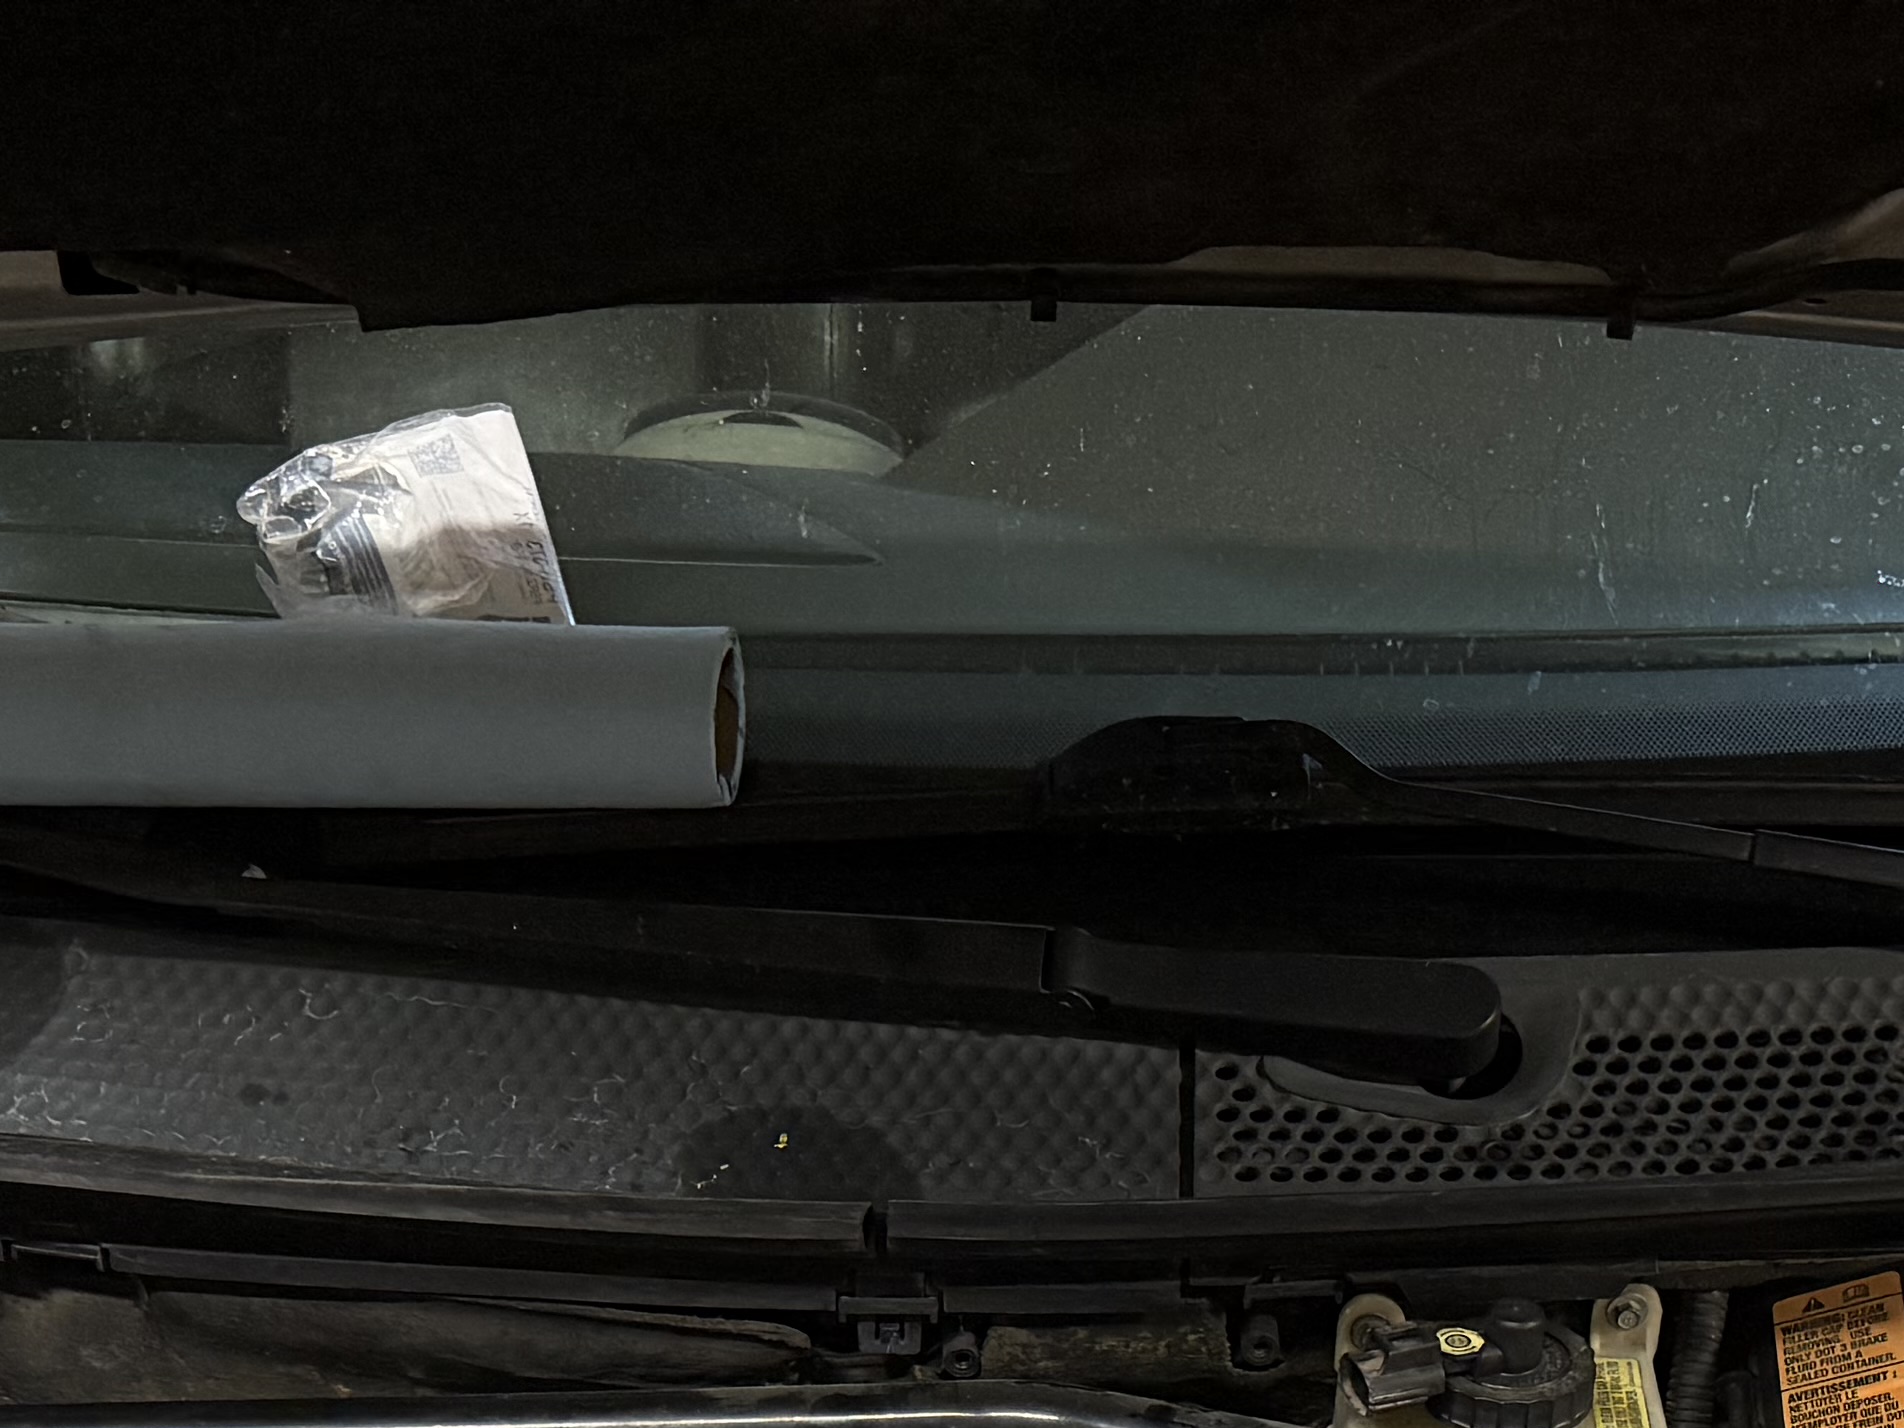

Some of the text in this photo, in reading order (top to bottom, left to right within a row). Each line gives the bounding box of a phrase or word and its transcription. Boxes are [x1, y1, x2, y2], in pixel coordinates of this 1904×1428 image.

[1850, 1327, 1872, 1339] USE
[1784, 1351, 1811, 1366] ONLY
[1816, 1347, 1835, 1358] DOT
[1785, 1350, 1862, 1376] FLUID FROM A
[1787, 1353, 1896, 1385] SEALED CONTAINER.
[1846, 1389, 1859, 1399] LE
[1791, 1405, 1840, 1424] BOUCHON
[1860, 1405, 1881, 1417] QUE
[1884, 1401, 1899, 1411] DU
[1853, 1416, 1883, 1428] FREIN
